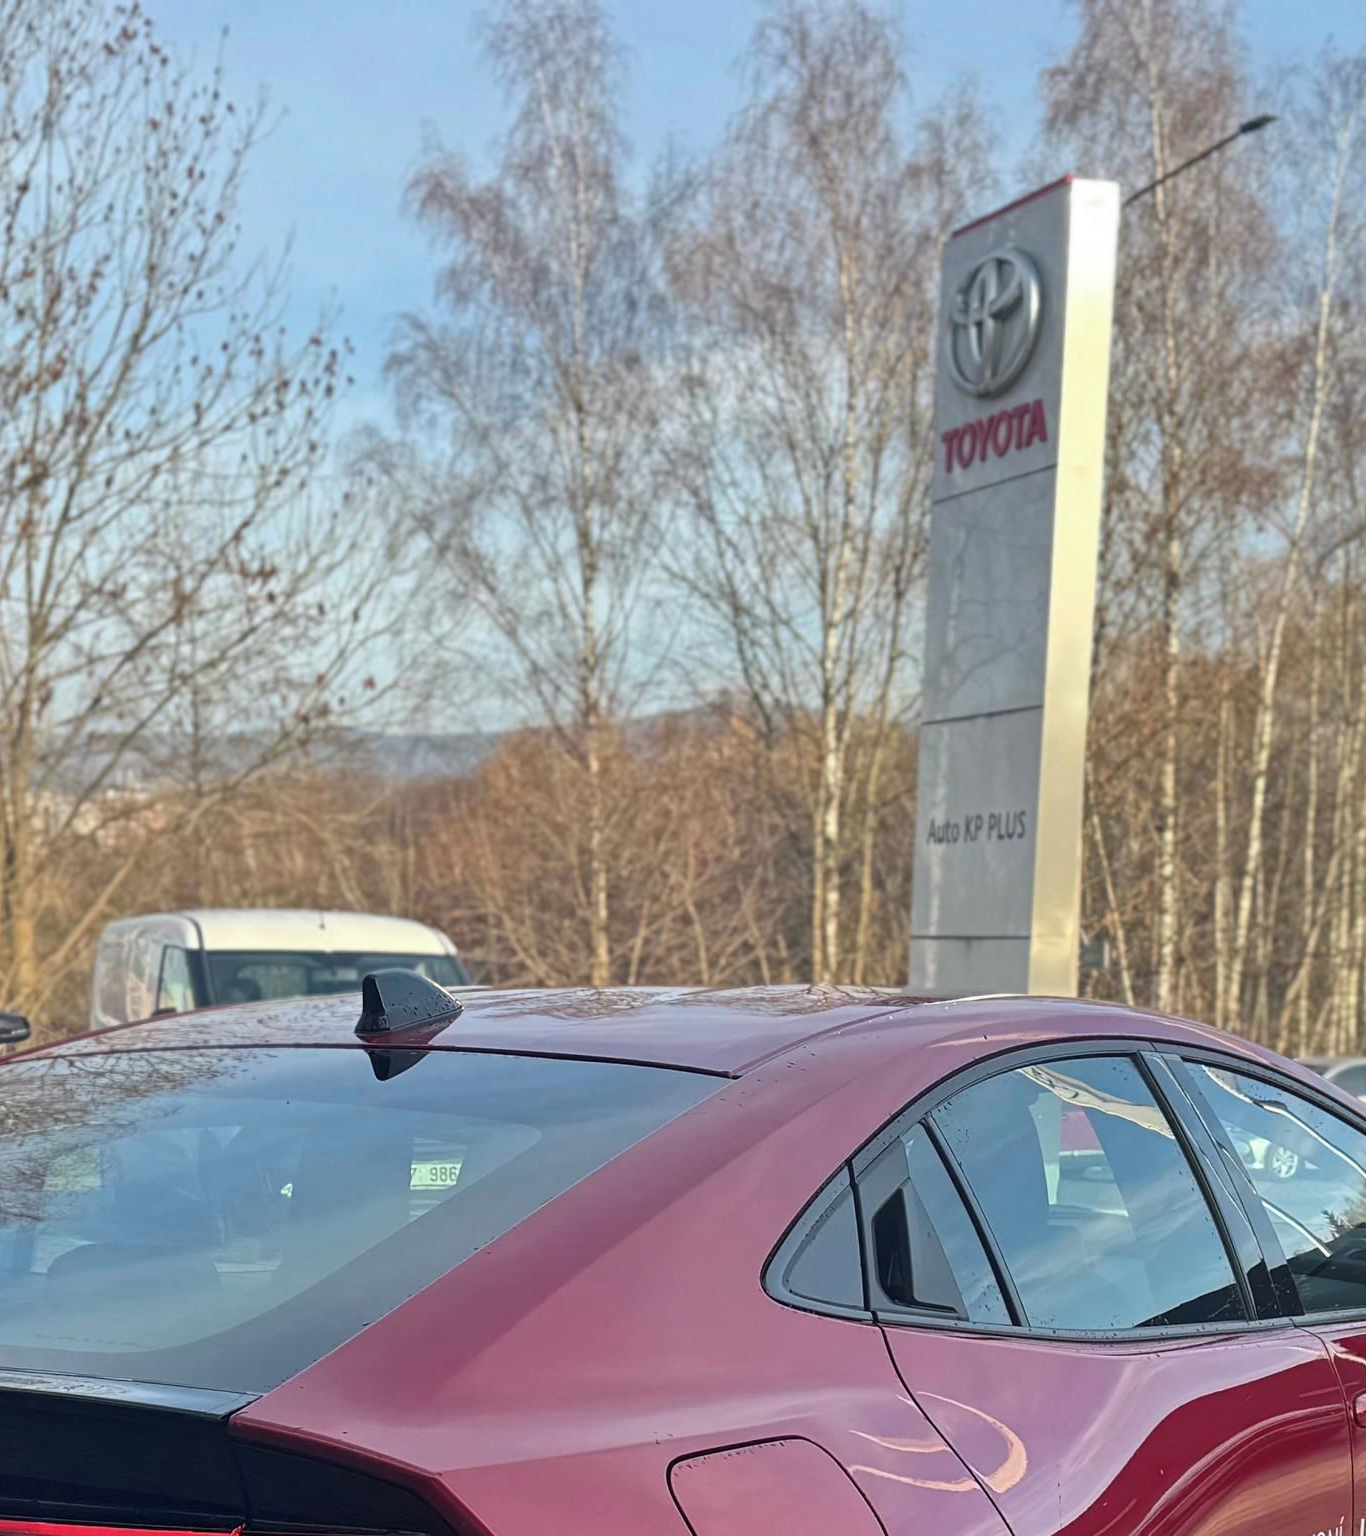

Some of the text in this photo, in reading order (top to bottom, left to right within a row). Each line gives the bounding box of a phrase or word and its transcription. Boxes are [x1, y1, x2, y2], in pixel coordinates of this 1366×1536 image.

[942, 398, 1048, 474] TOYOTA
[926, 810, 1026, 846] Auto KP PLUS
